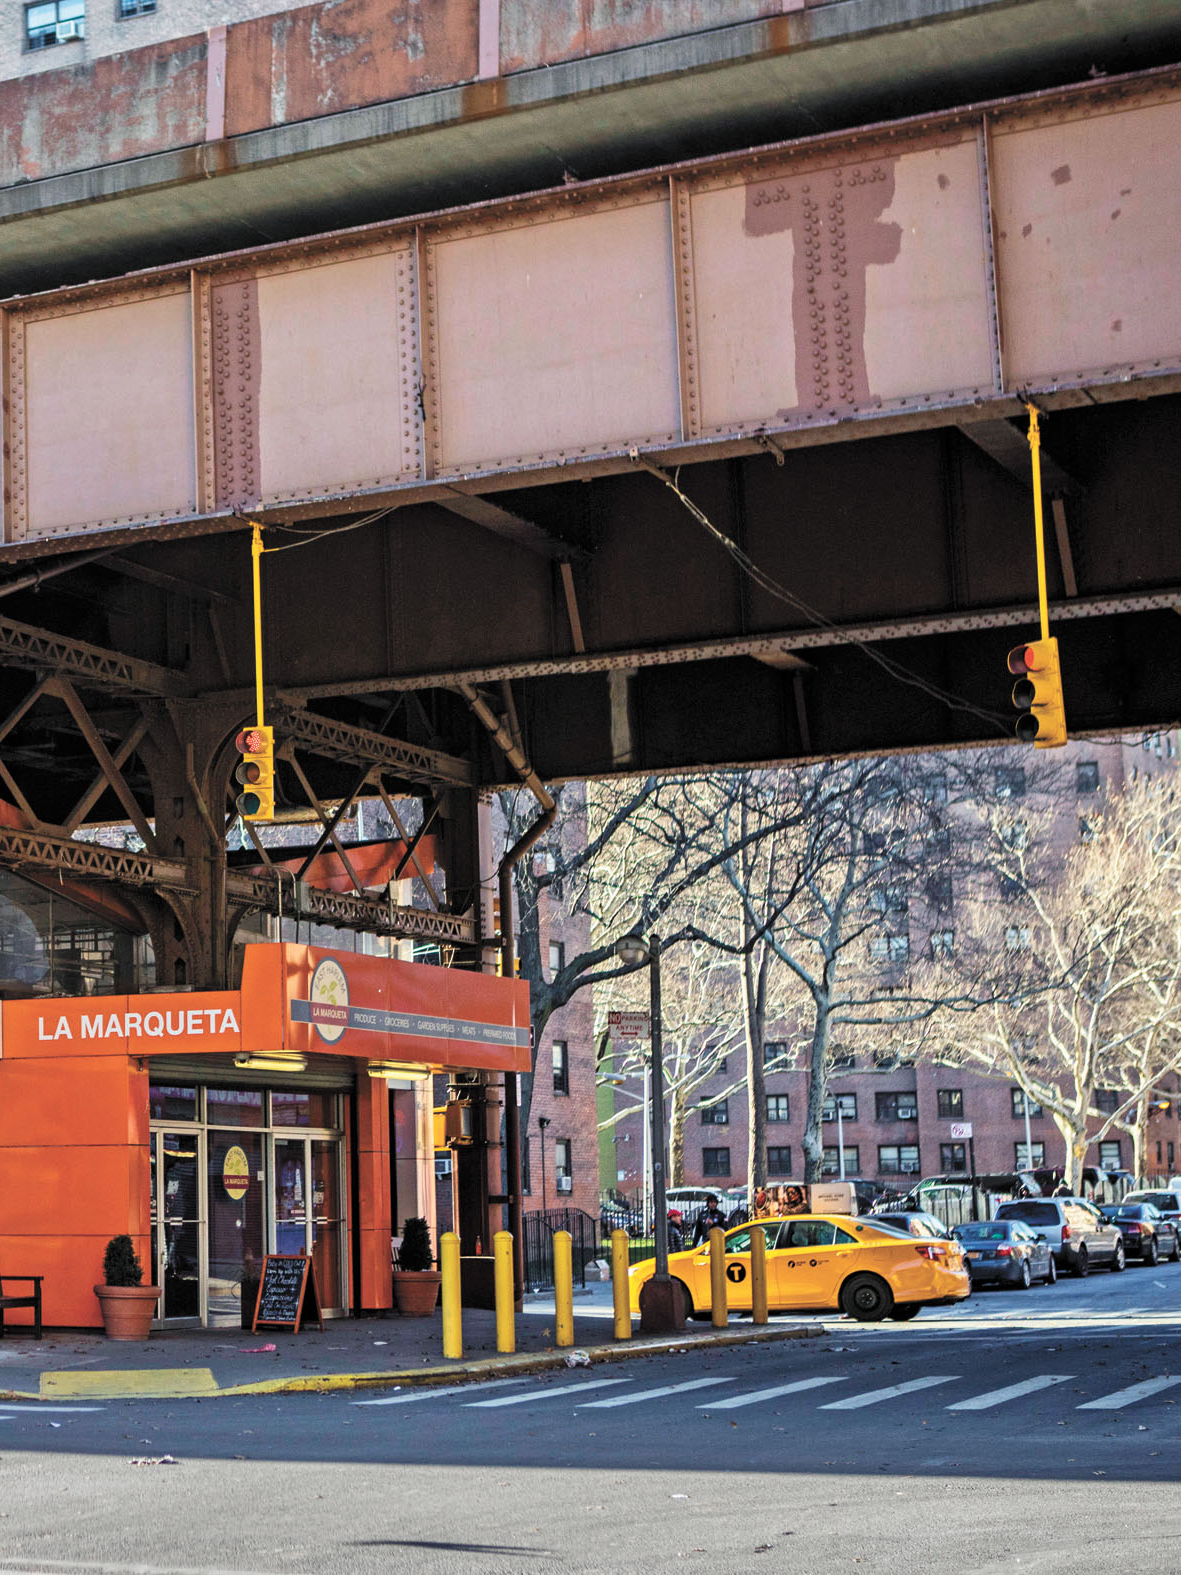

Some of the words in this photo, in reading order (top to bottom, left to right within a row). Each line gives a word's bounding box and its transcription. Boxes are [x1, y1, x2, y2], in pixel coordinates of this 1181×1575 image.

[312, 1008, 319, 1017] LA
[321, 1008, 347, 1019] MARQUETA
[609, 1013, 621, 1023] NO
[38, 1016, 73, 1041] LA
[81, 1009, 240, 1039] MARQUETA
[354, 1013, 376, 1024] PRODUCE
[384, 1017, 409, 1028] GROCERIES
[418, 1020, 436, 1031] GARDEN
[436, 1023, 455, 1033] SUPPLIES
[462, 1026, 476, 1035] MEATS
